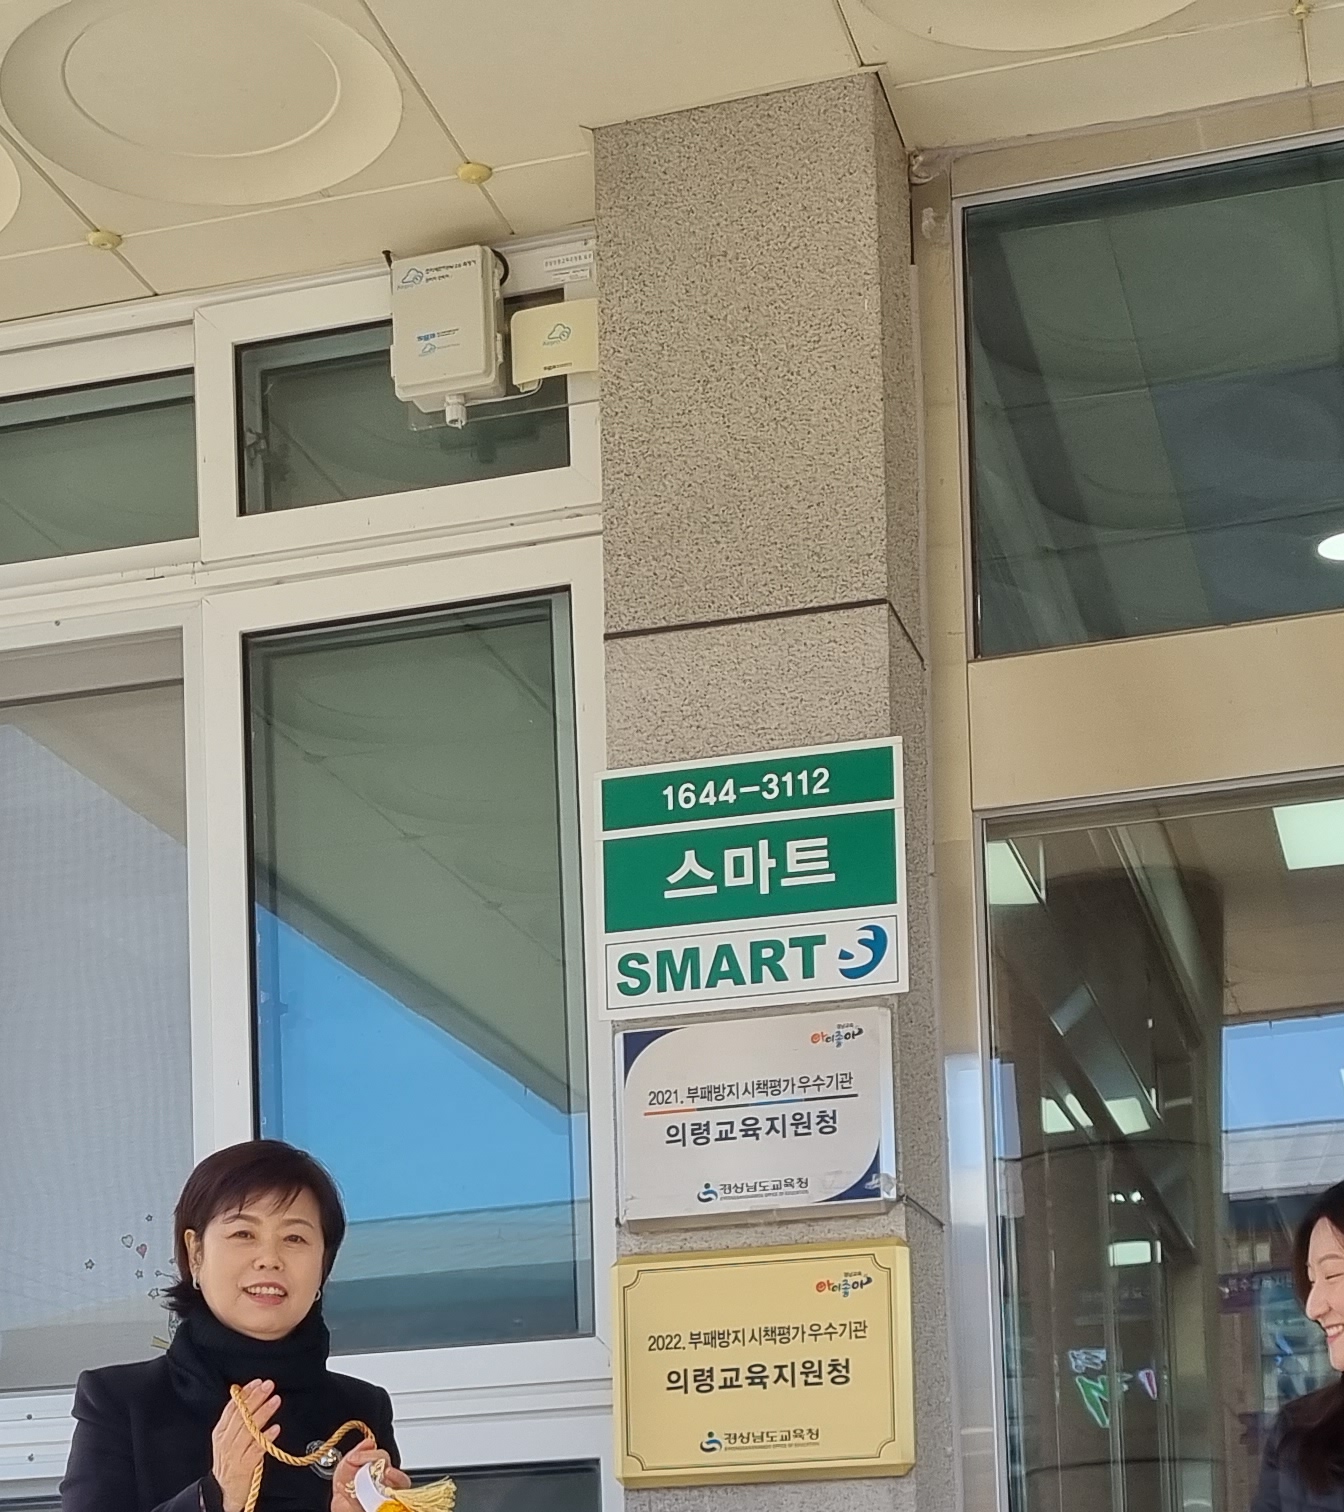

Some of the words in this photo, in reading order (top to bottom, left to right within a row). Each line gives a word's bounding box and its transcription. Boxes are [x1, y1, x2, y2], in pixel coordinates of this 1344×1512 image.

[662, 768, 830, 810] 1644-3112
[664, 837, 836, 899] 스마트
[616, 934, 827, 997] SMART
[648, 1089, 684, 1106] 2021.
[686, 1084, 740, 1104] 부패방지
[742, 1076, 796, 1098] 시책평가
[797, 1072, 853, 1093] 우수기관
[665, 1109, 838, 1147] 의령교육지원청
[648, 1335, 686, 1352] 2022.
[688, 1328, 746, 1350] 부패방지
[748, 1324, 806, 1346] 시책평가
[808, 1320, 868, 1342] 우수기관
[666, 1358, 851, 1395] 의령교육지원청
[724, 1427, 820, 1446] 경상남도교육청
